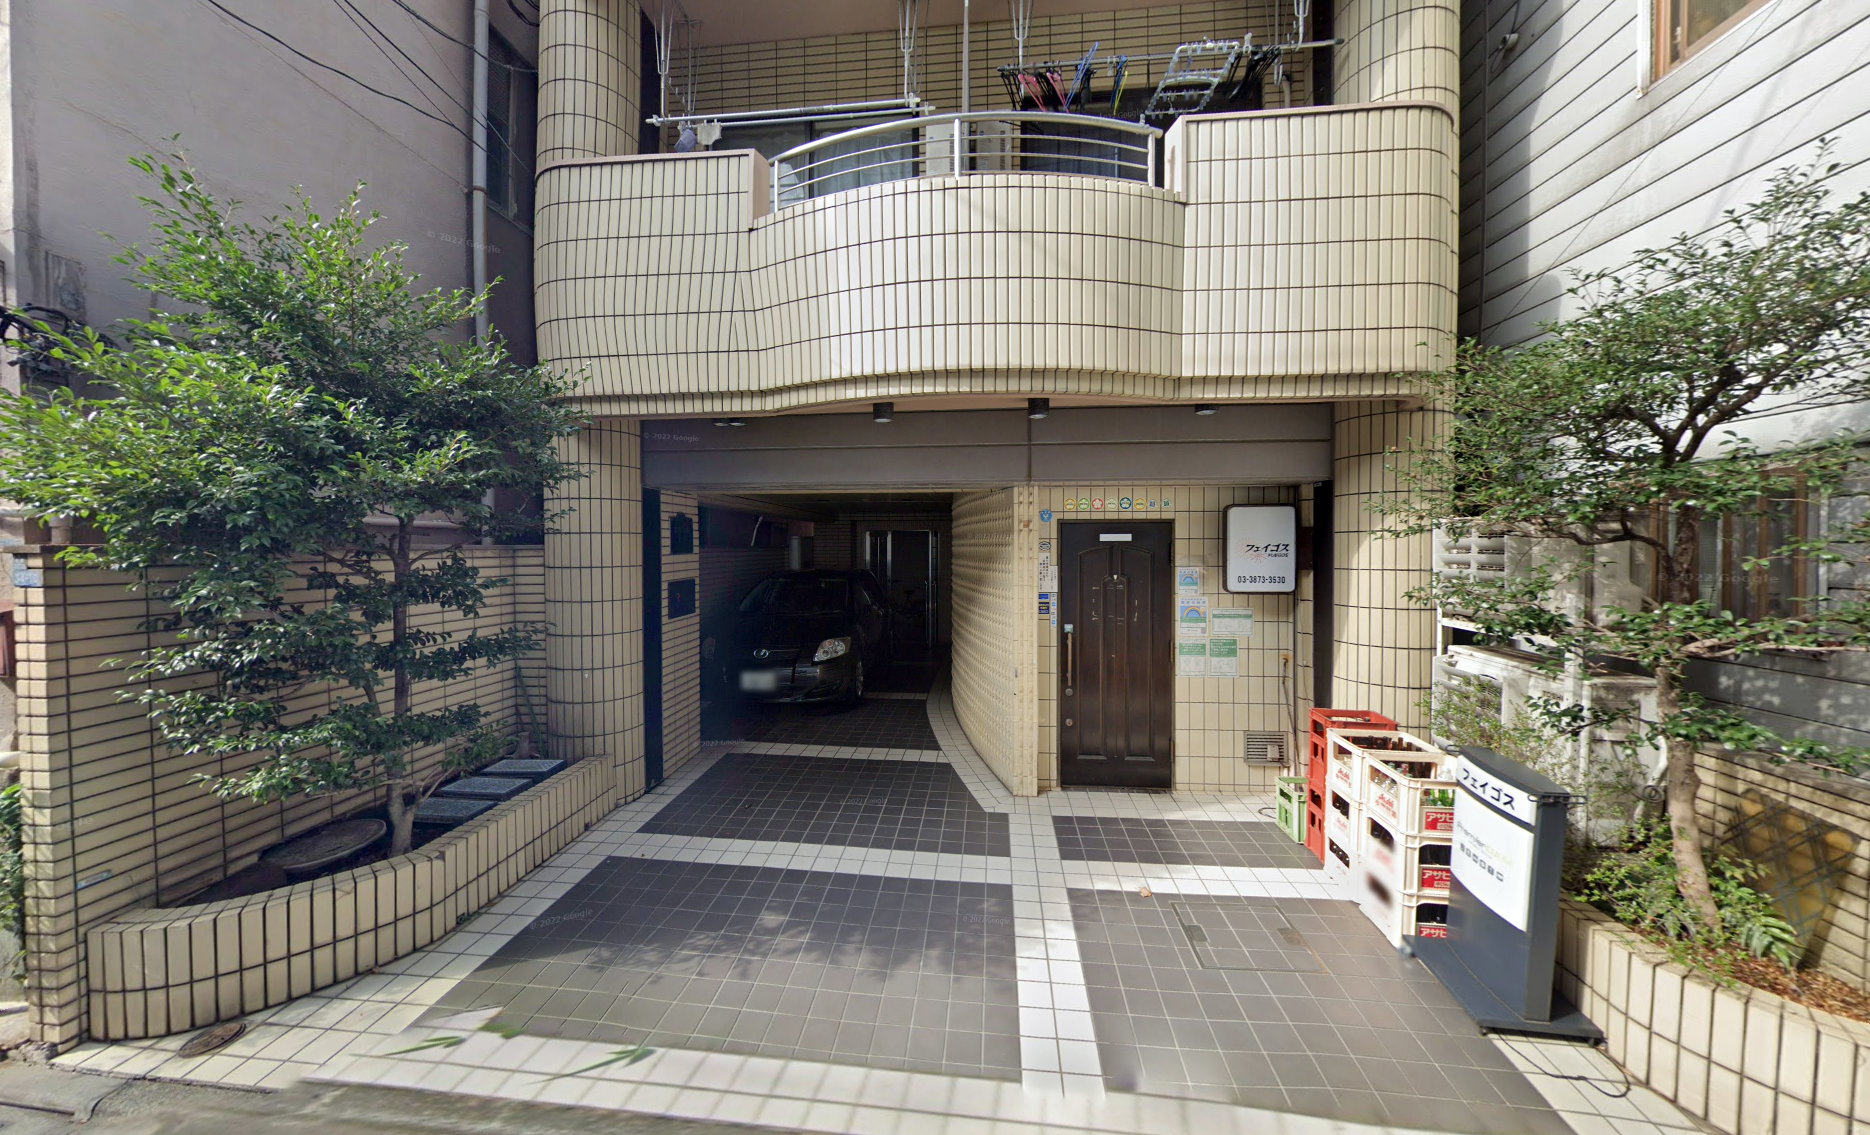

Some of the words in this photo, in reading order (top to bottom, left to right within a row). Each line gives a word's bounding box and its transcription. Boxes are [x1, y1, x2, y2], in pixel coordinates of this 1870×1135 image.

[1245, 543, 1290, 553] フェイゴス
[1237, 575, 1286, 584] 03-3873-3530
[1463, 767, 1515, 811] フェイゴス
